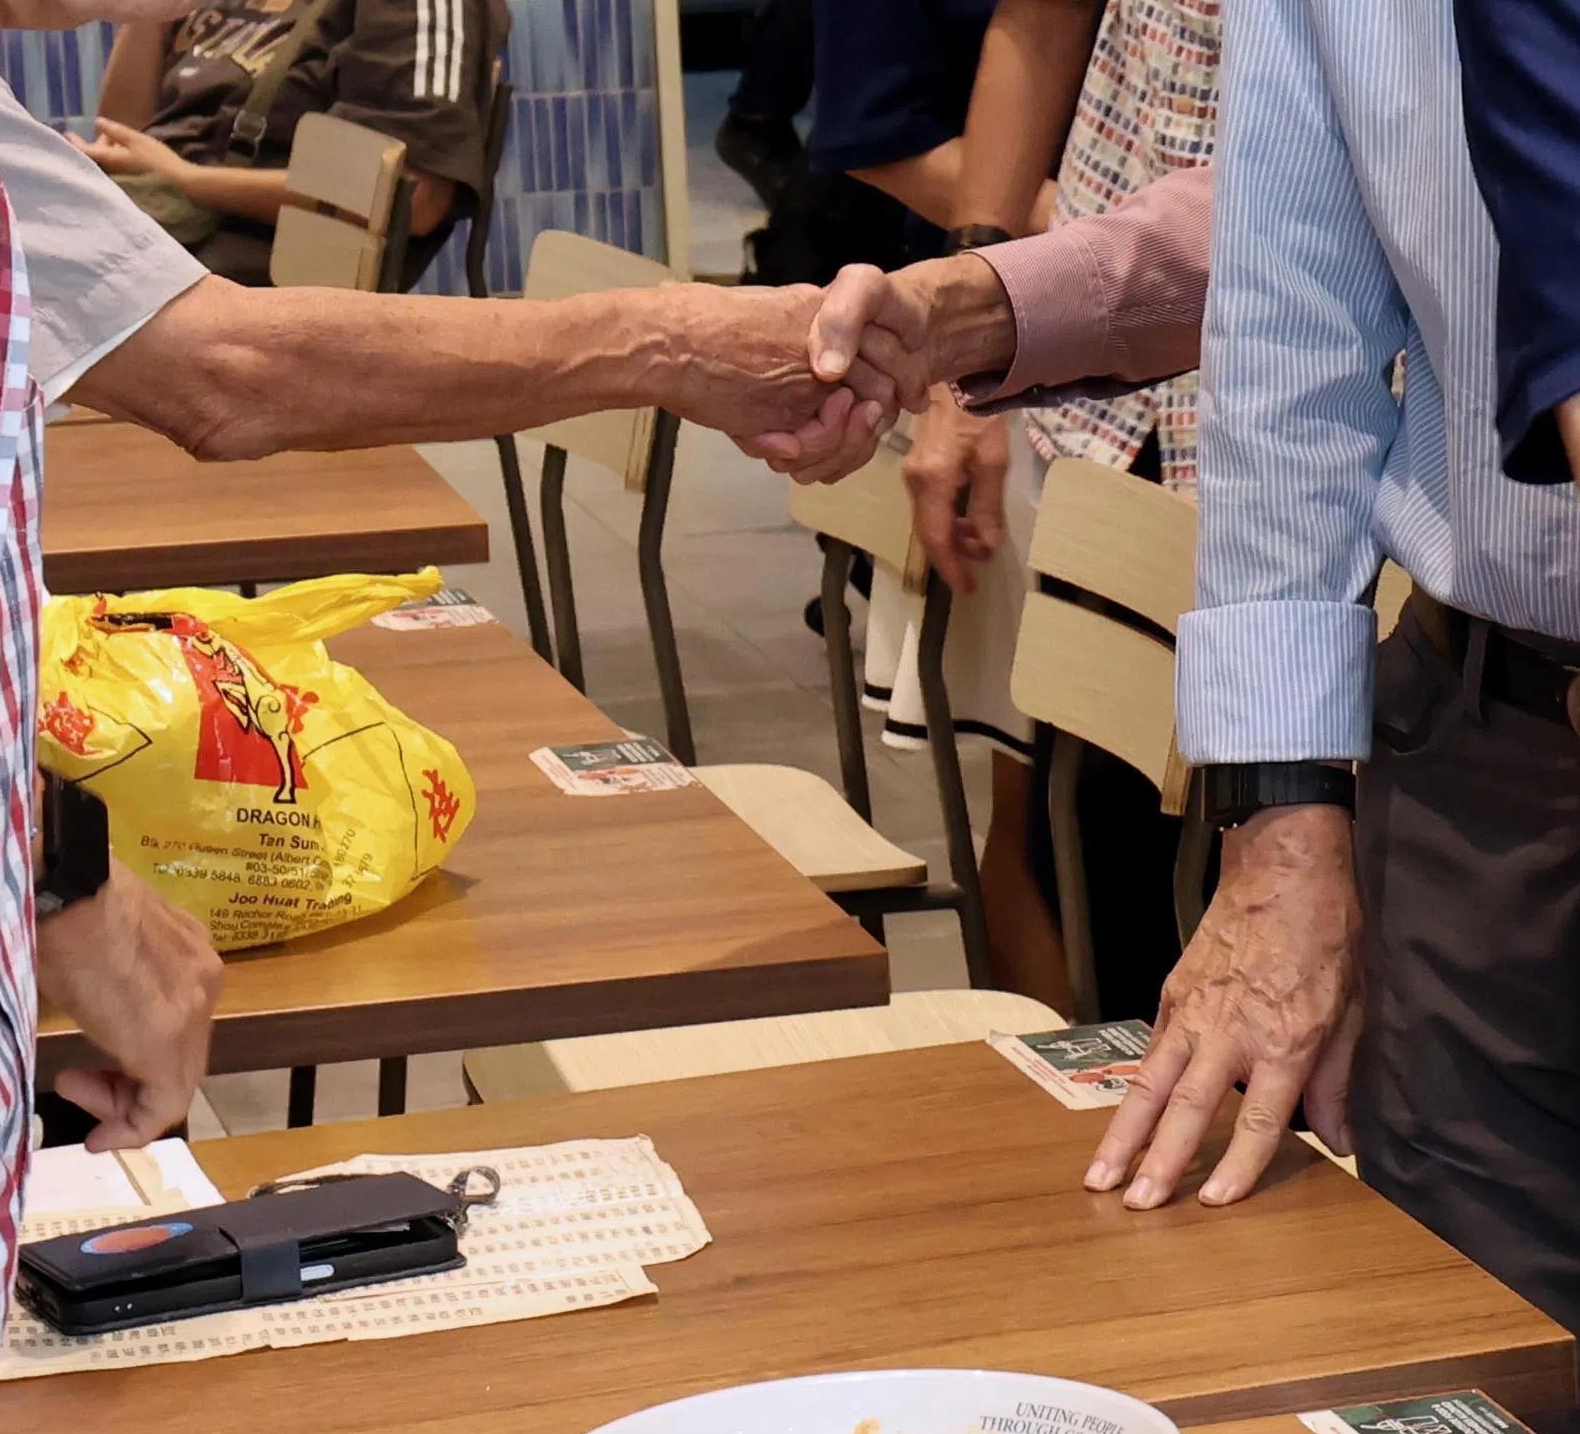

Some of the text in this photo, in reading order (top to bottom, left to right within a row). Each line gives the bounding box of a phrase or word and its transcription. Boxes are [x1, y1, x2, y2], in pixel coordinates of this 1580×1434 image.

[236, 807, 314, 828] DRAGON
[228, 892, 353, 910] Joo Huat Trading
[1015, 1402, 1082, 1427] UNITING
